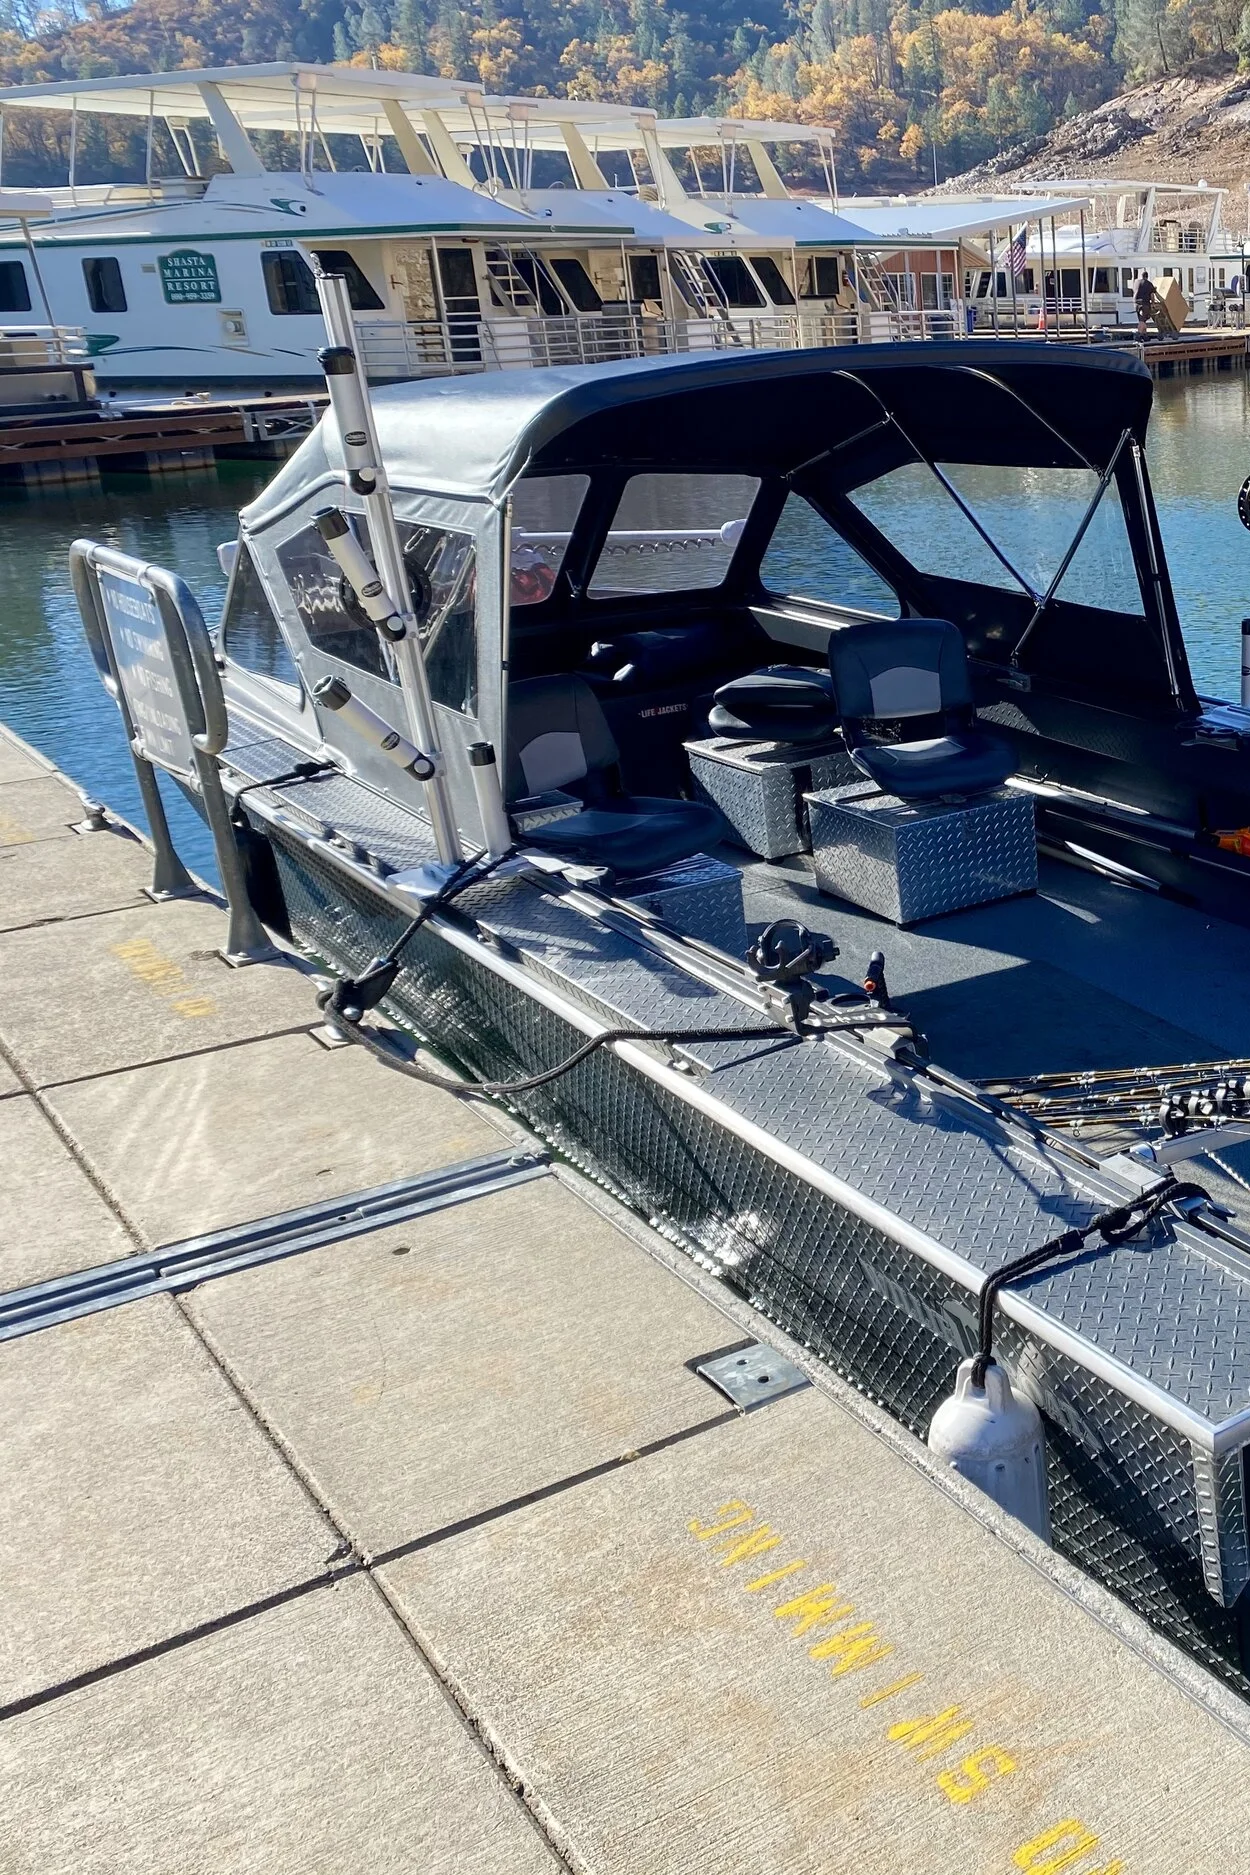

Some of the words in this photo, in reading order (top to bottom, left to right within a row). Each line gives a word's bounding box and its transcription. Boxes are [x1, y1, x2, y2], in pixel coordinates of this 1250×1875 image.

[167, 256, 206, 266] SHASTA
[163, 267, 214, 278] MARINA
[166, 281, 215, 291] RESORT
[640, 708, 656, 718] LIFE
[657, 703, 689, 715] JACKETS
[687, 1499, 1016, 1805] SWIMMING
[1013, 1817, 1125, 1875] O
